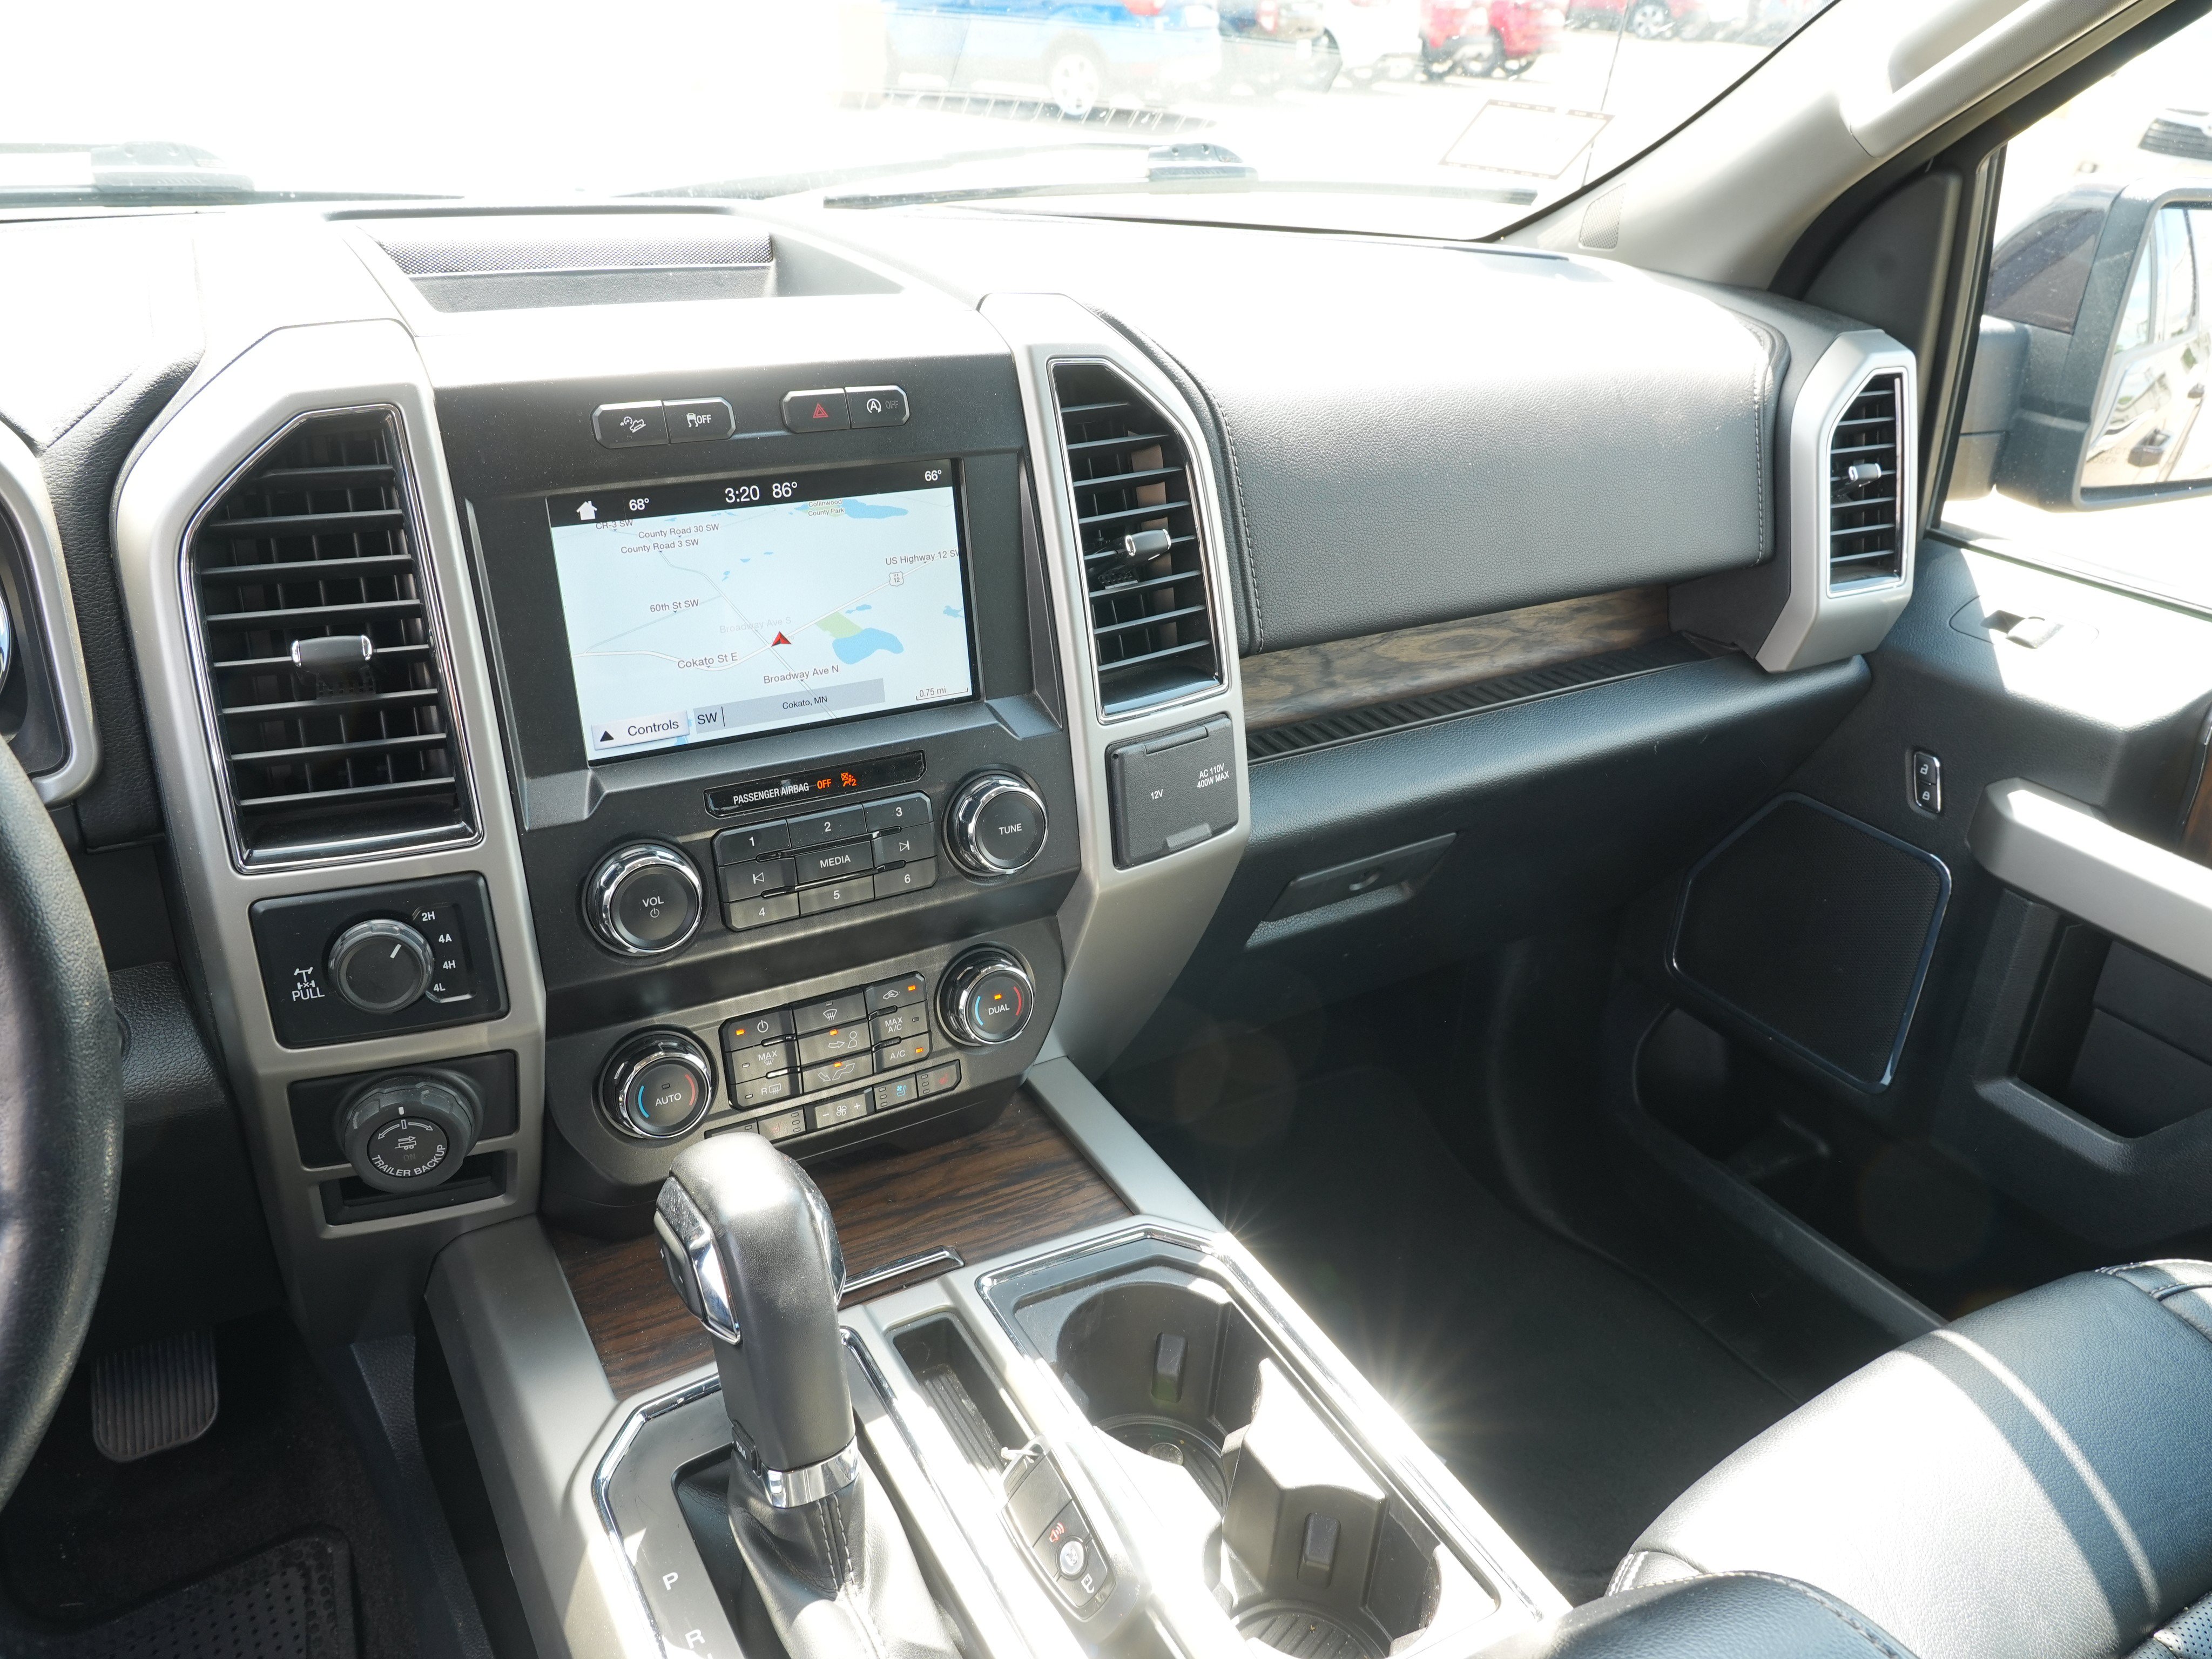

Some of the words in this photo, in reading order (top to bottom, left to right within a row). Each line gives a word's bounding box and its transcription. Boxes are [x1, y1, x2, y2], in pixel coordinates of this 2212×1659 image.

[885, 400, 899, 409] OFF
[697, 414, 712, 424] OFF
[925, 470, 941, 481] 66°
[725, 485, 760, 502] 3:20
[772, 481, 797, 498] 86°
[629, 497, 649, 511] 68°
[808, 499, 842, 507] Collinwood
[596, 521, 617, 529] CR-3
[638, 529, 667, 539] County
[670, 527, 691, 535] Road
[705, 523, 719, 531] SW
[621, 544, 650, 554] County
[653, 542, 675, 550] Road
[885, 557, 898, 565] US
[900, 552, 935, 564] Highway
[650, 602, 669, 612] 60th
[672, 601, 682, 609] St
[685, 599, 699, 608] SW
[720, 622, 763, 633] Broadway
[677, 657, 713, 669] Cokato
[717, 655, 727, 663] St
[763, 669, 810, 683] Broadway
[813, 667, 829, 676] Ave
[919, 687, 934, 697] 0.75
[937, 686, 946, 694] mi
[783, 698, 811, 709] Cokato,
[697, 712, 717, 725] SW
[628, 719, 679, 736] Controls
[1199, 769, 1209, 778] AC
[1210, 763, 1224, 775] 110V
[1197, 776, 1214, 788] 400W
[1215, 771, 1229, 782] MAX
[733, 788, 779, 804] PASSENGER
[780, 782, 809, 794] AIRBAG
[817, 778, 831, 790] OFF
[1150, 788, 1163, 799] 12V
[896, 807, 902, 817] 3
[824, 821, 831, 831] 2
[999, 823, 1022, 834] TUNE
[749, 836, 755, 846] 1
[820, 854, 851, 868] MEDIA
[904, 874, 911, 883] 6
[833, 890, 840, 900] 5
[642, 896, 664, 907] VOL
[422, 912, 435, 921] 2H
[759, 907, 765, 916] 4
[439, 934, 452, 943] 4A
[443, 960, 455, 969] 4H
[433, 983, 445, 992] 4L
[292, 988, 325, 1001] PULL
[988, 1003, 1009, 1015] DUAL
[885, 1017, 902, 1027] MAX
[888, 1022, 902, 1032] A/C
[758, 1050, 777, 1060] MAX
[890, 1049, 905, 1060] A/C
[761, 1087, 767, 1095] R
[655, 1092, 681, 1106] AUTO
[372, 1155, 410, 1176] TRAILER
[413, 1144, 445, 1175] BACKUP
[662, 1572, 678, 1590] P
[685, 1629, 705, 1649] R
